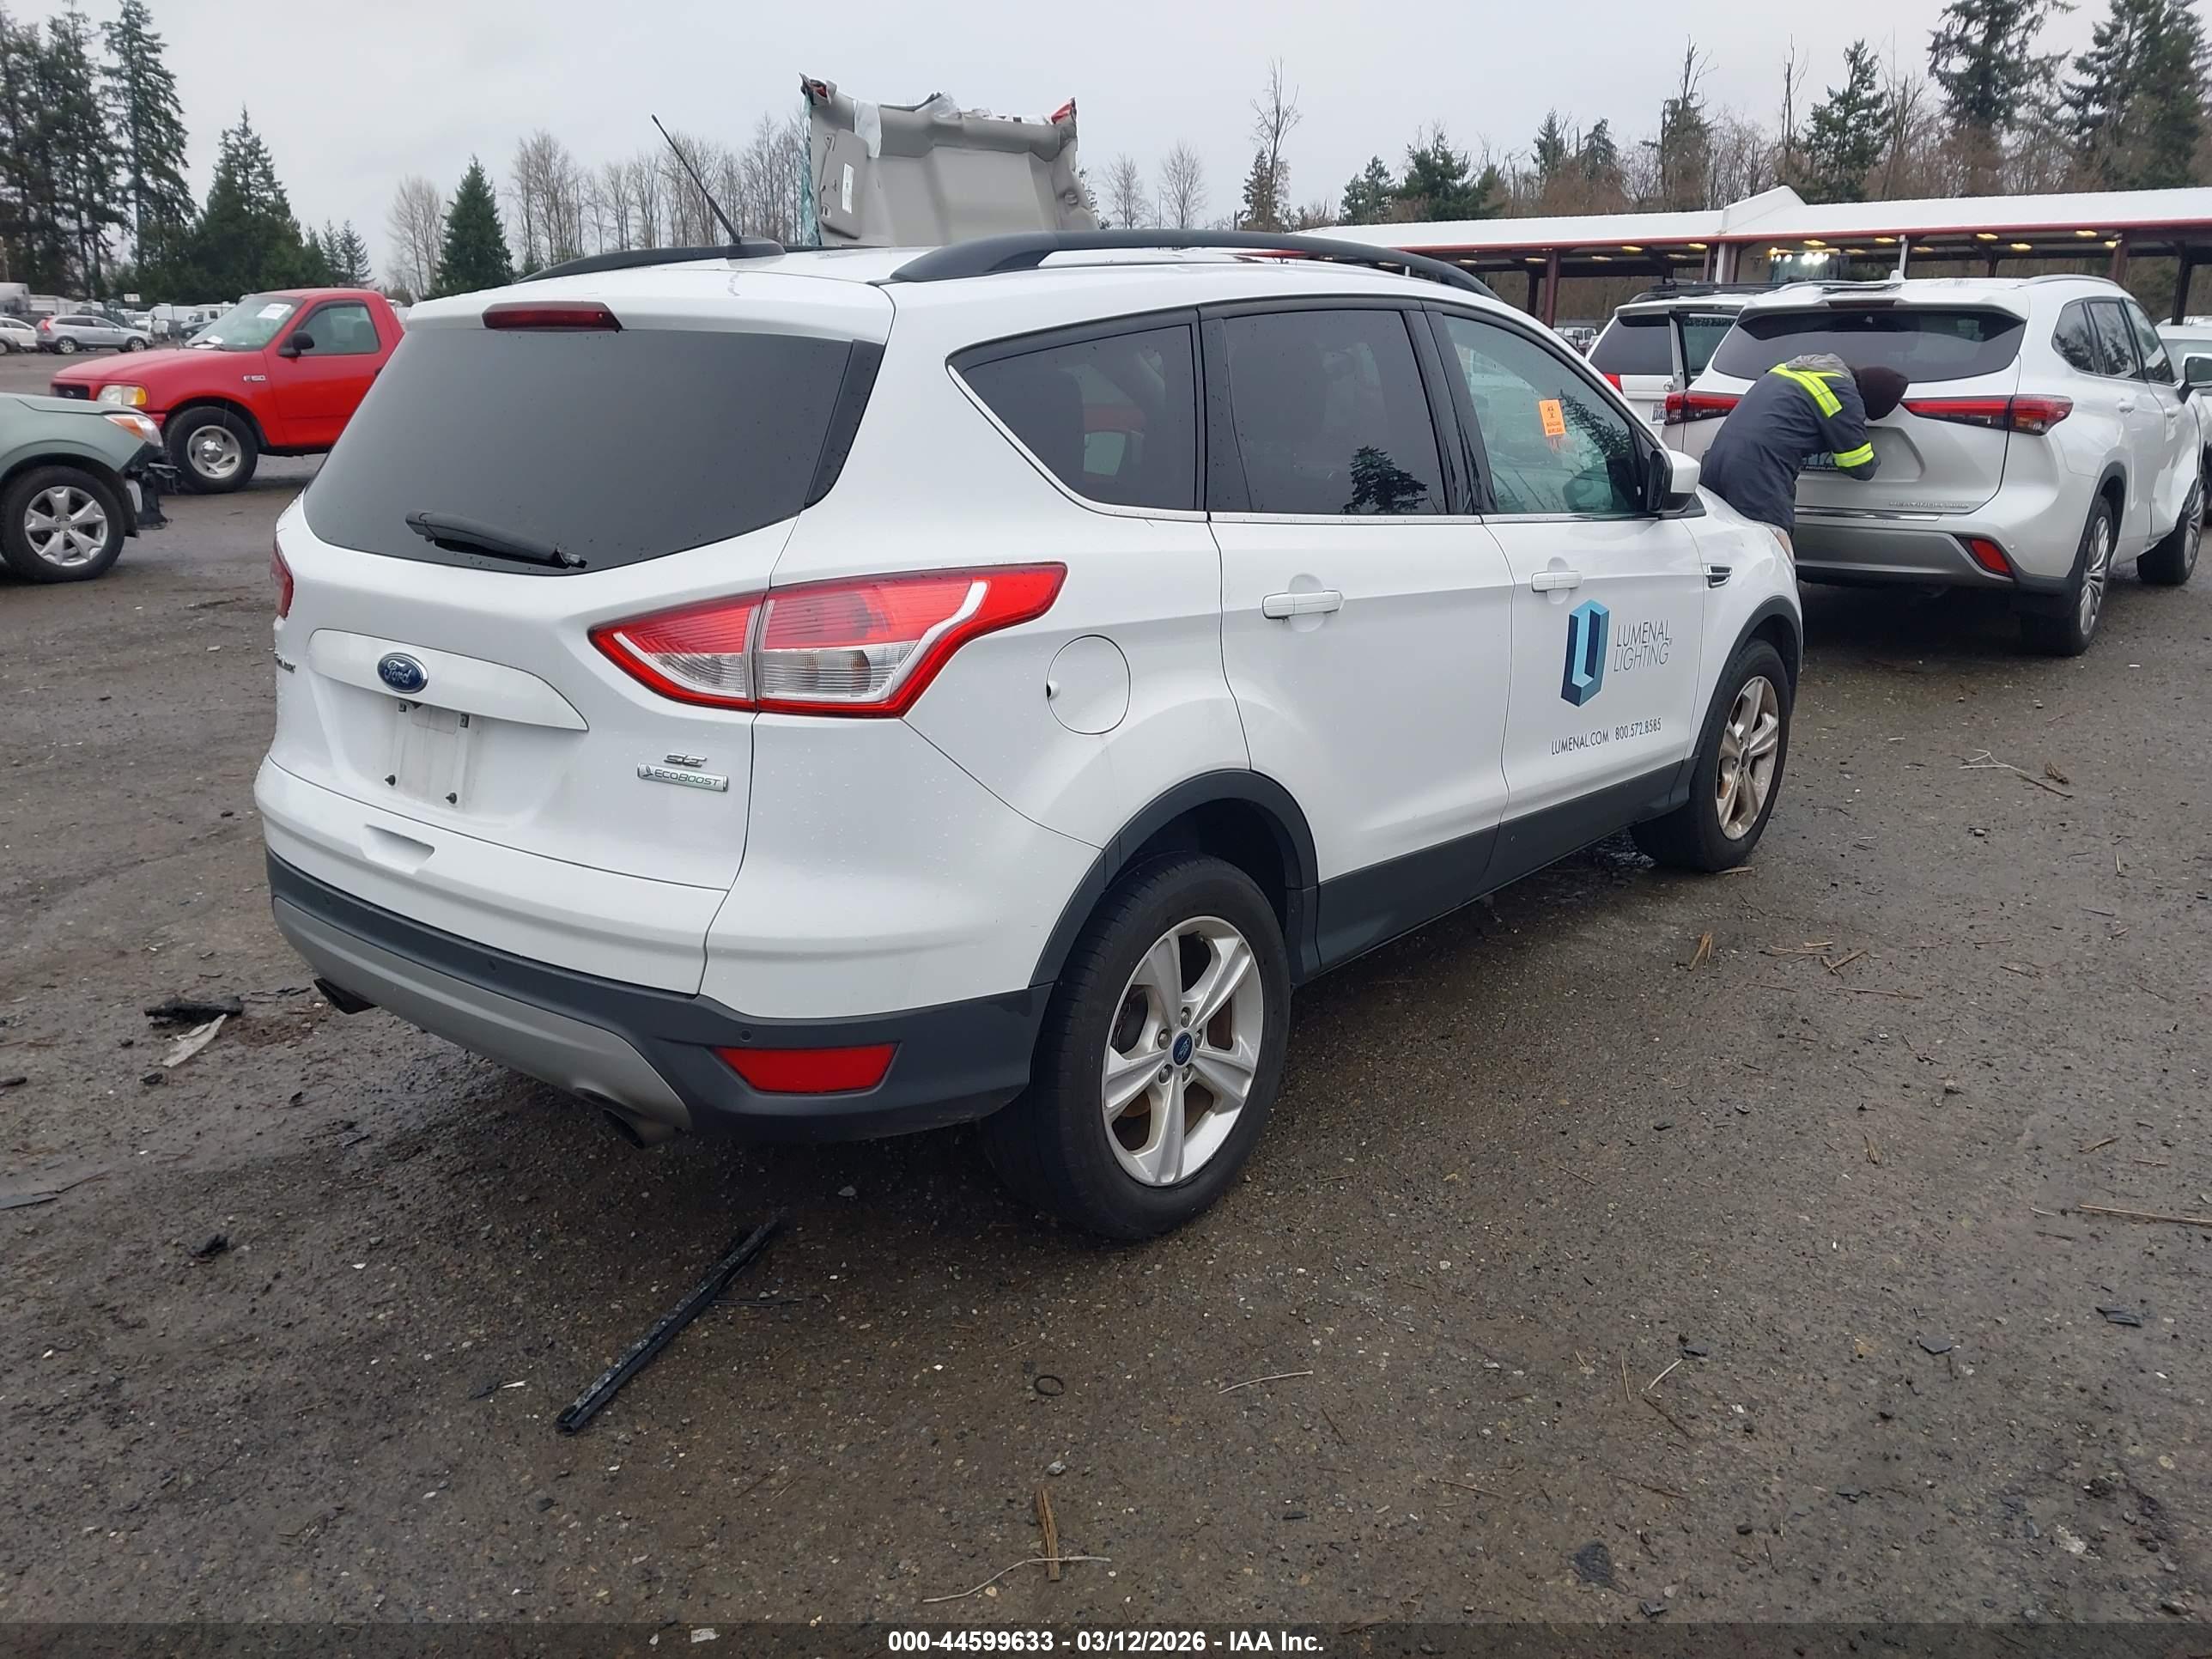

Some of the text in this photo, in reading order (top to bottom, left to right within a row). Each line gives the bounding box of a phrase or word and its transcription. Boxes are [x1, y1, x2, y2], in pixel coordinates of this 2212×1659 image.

[1617, 618, 1670, 647] LUMENAL
[1614, 641, 1668, 672] LIGHTING
[384, 659, 412, 684] Ford
[1551, 717, 1662, 755] LUMENAL.COM 800.572.8585
[664, 753, 708, 768] SE
[654, 769, 721, 787] ECOBOOST
